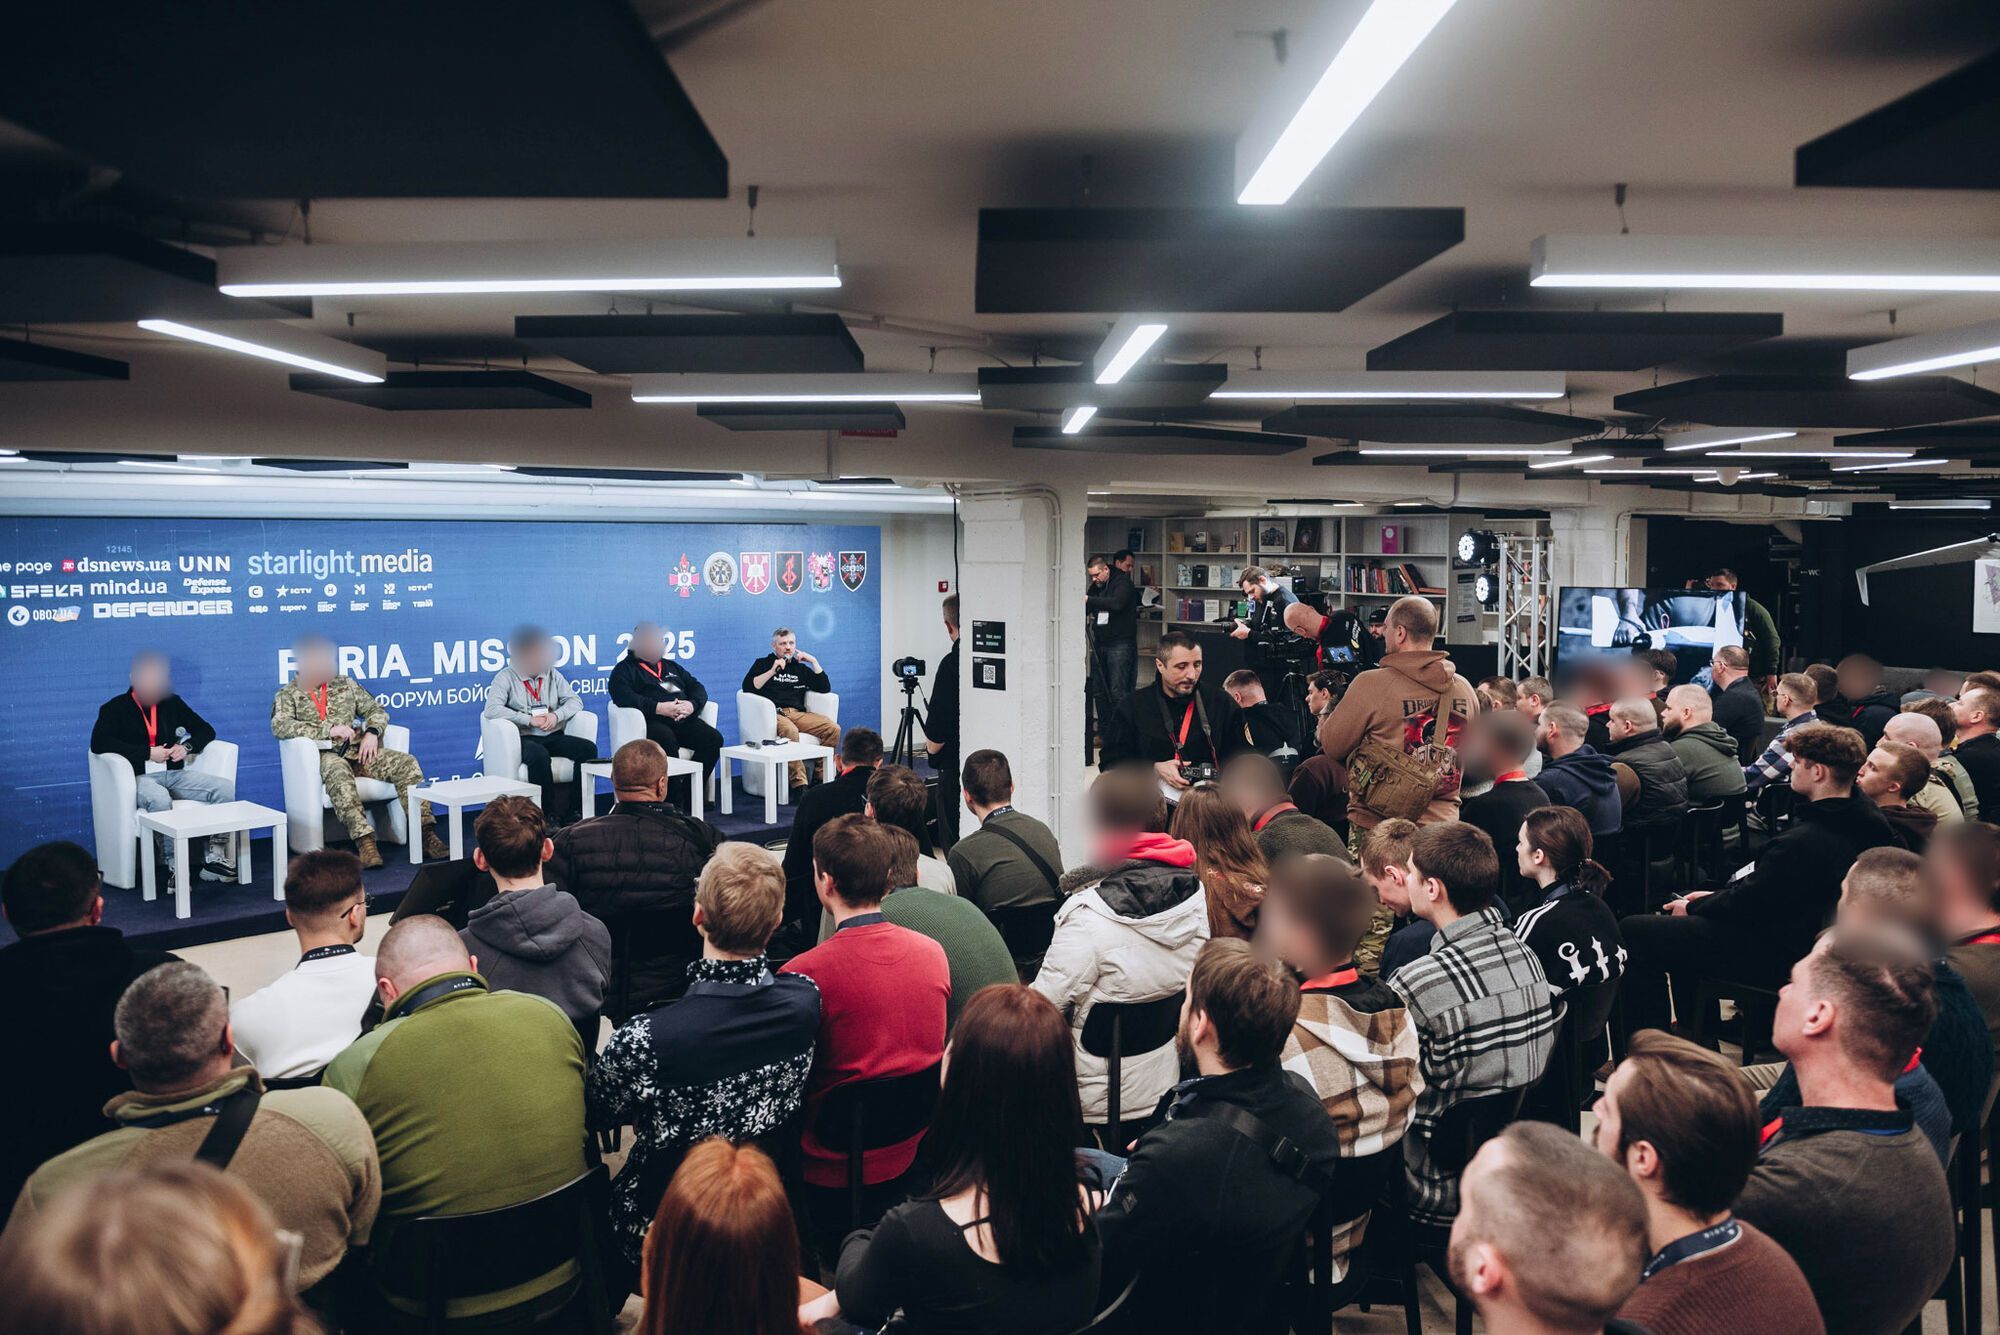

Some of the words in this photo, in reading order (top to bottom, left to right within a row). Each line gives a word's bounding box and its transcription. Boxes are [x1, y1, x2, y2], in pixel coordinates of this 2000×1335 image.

[16, 562, 53, 575] page
[77, 557, 172, 572] dsnews.ua
[179, 556, 231, 572] UNN
[1807, 569, 1821, 577] WC
[90, 579, 168, 595] mind.ua
[183, 577, 227, 587] Defense
[10, 584, 84, 598] SPEKA
[190, 585, 232, 596] Express
[93, 600, 233, 618] DEFENDER
[374, 690, 442, 709] ФОРУМ
